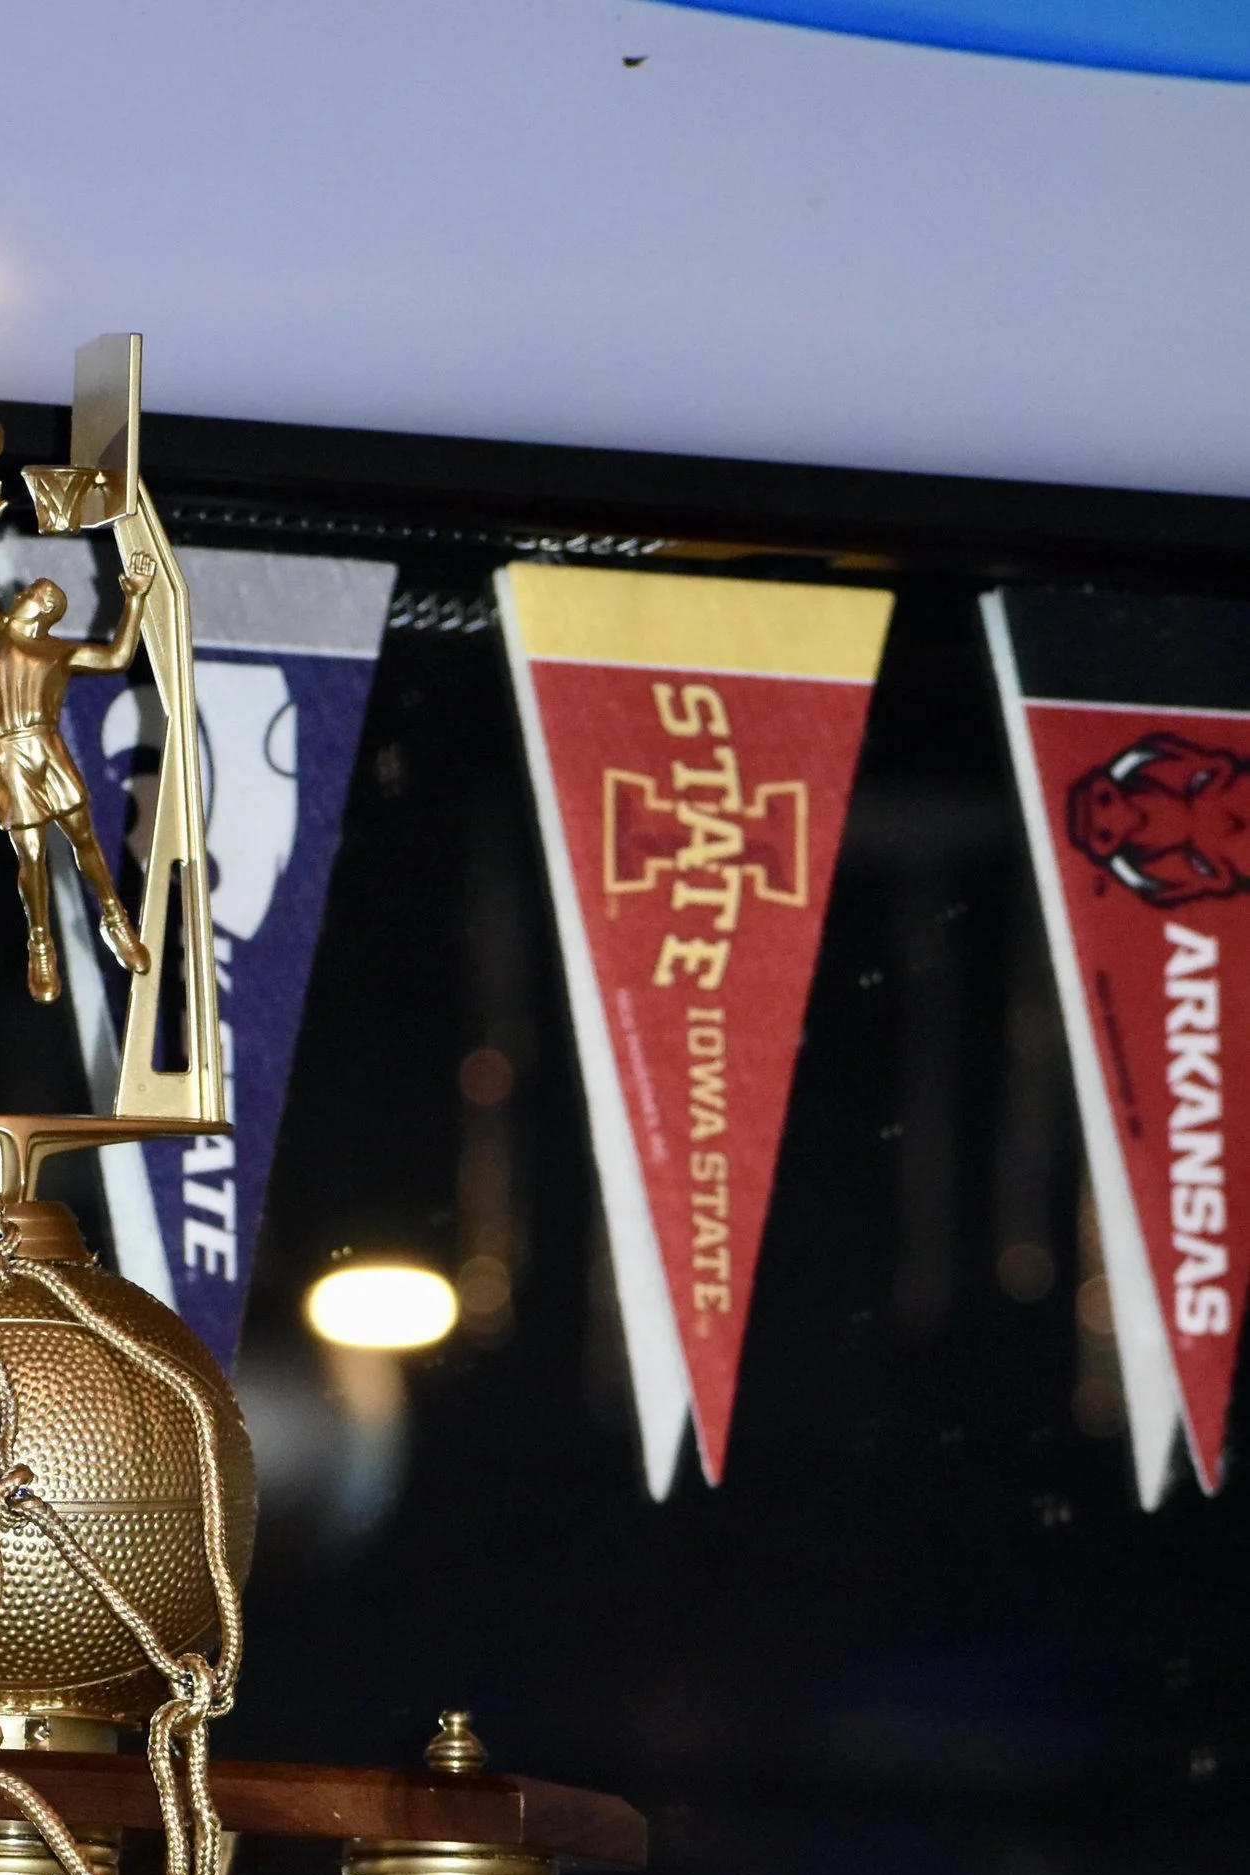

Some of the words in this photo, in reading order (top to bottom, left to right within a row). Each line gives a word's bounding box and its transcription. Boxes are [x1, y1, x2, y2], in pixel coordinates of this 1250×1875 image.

[652, 683, 742, 990] STATE
[687, 1006, 725, 1141] IOWA
[1165, 921, 1230, 1338] ARKANSAS
[690, 1152, 732, 1315] STATE
